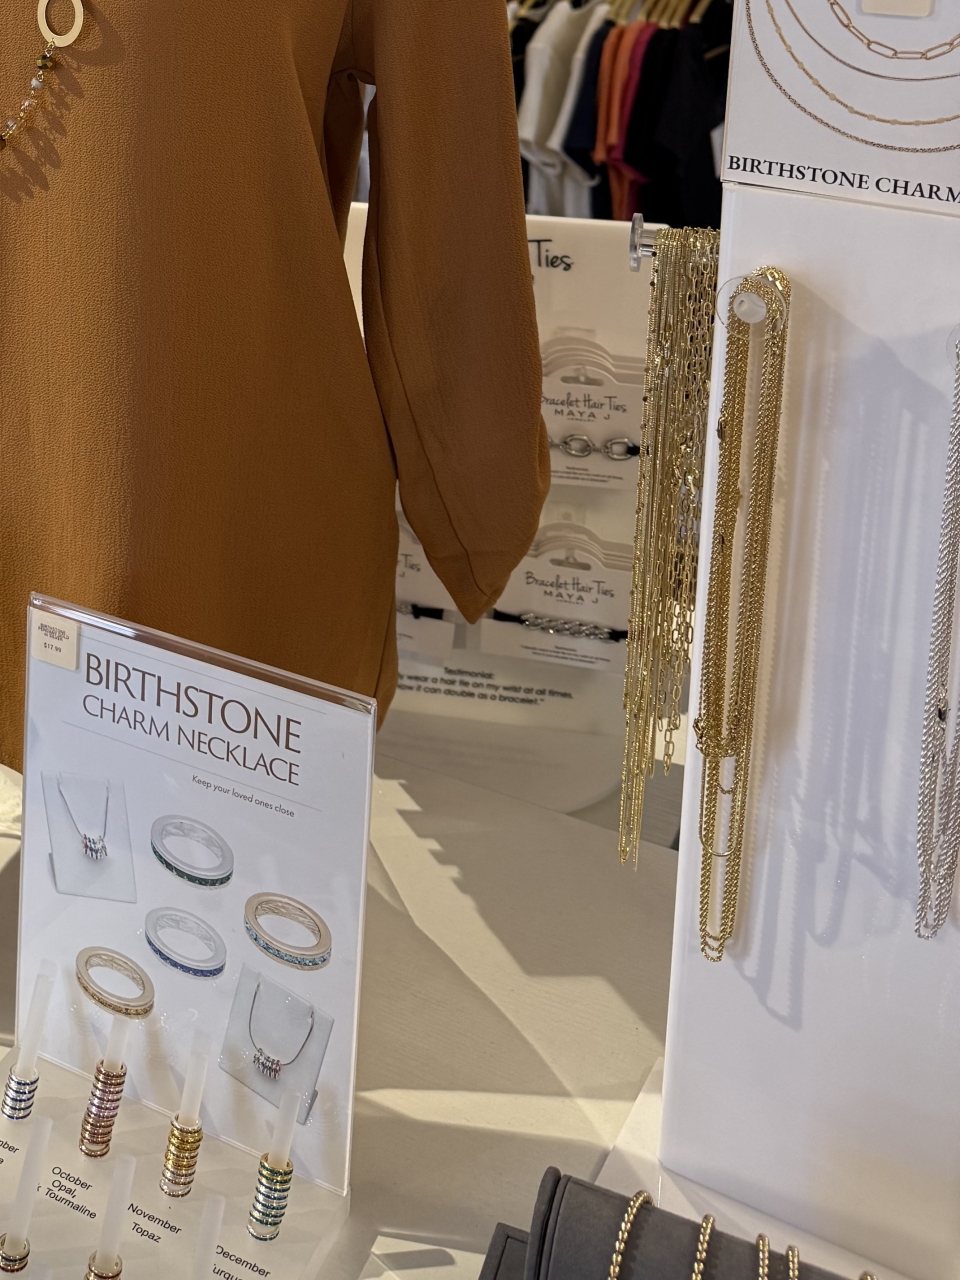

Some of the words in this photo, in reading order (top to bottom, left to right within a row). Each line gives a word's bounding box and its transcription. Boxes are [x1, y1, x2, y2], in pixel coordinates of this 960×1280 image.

[727, 154, 870, 190] BIRTHSTONE
[528, 239, 574, 272] Ties
[554, 408, 597, 419] MAYA
[603, 413, 611, 421] J
[582, 393, 605, 410] Hair
[603, 395, 627, 413] Ties
[400, 553, 421, 572] Ties
[525, 571, 569, 591] Bracelet
[572, 576, 594, 593] Hair
[592, 580, 615, 599] Ties
[543, 590, 585, 602] MAYA
[591, 597, 599, 605] J
[44, 642, 62, 653] $17.99
[407, 675, 429, 683] wear
[440, 676, 457, 686] hair
[458, 679, 471, 688] tie
[471, 681, 485, 689] on
[486, 683, 500, 692] my
[501, 684, 522, 694] wrist
[523, 686, 534, 695] at
[535, 688, 547, 696] all
[415, 684, 422, 692] it
[423, 686, 442, 694] can
[443, 687, 476, 699] double
[477, 691, 488, 700] as
[489, 693, 497, 701] a
[85, 652, 302, 754] BIRTHSTONE
[82, 694, 170, 742] CHARM
[177, 724, 300, 787] NECKLACE
[192, 774, 212, 789] Keep
[213, 784, 231, 795] your
[231, 788, 254, 803] loved
[254, 798, 273, 810] ones
[274, 804, 295, 818] close
[51, 1166, 93, 1191] October
[51, 1179, 77, 1199] Opal,
[44, 1187, 97, 1219] Tourmaline
[127, 1202, 182, 1235] November
[131, 1221, 162, 1244] Topaz
[215, 1245, 271, 1278] December
